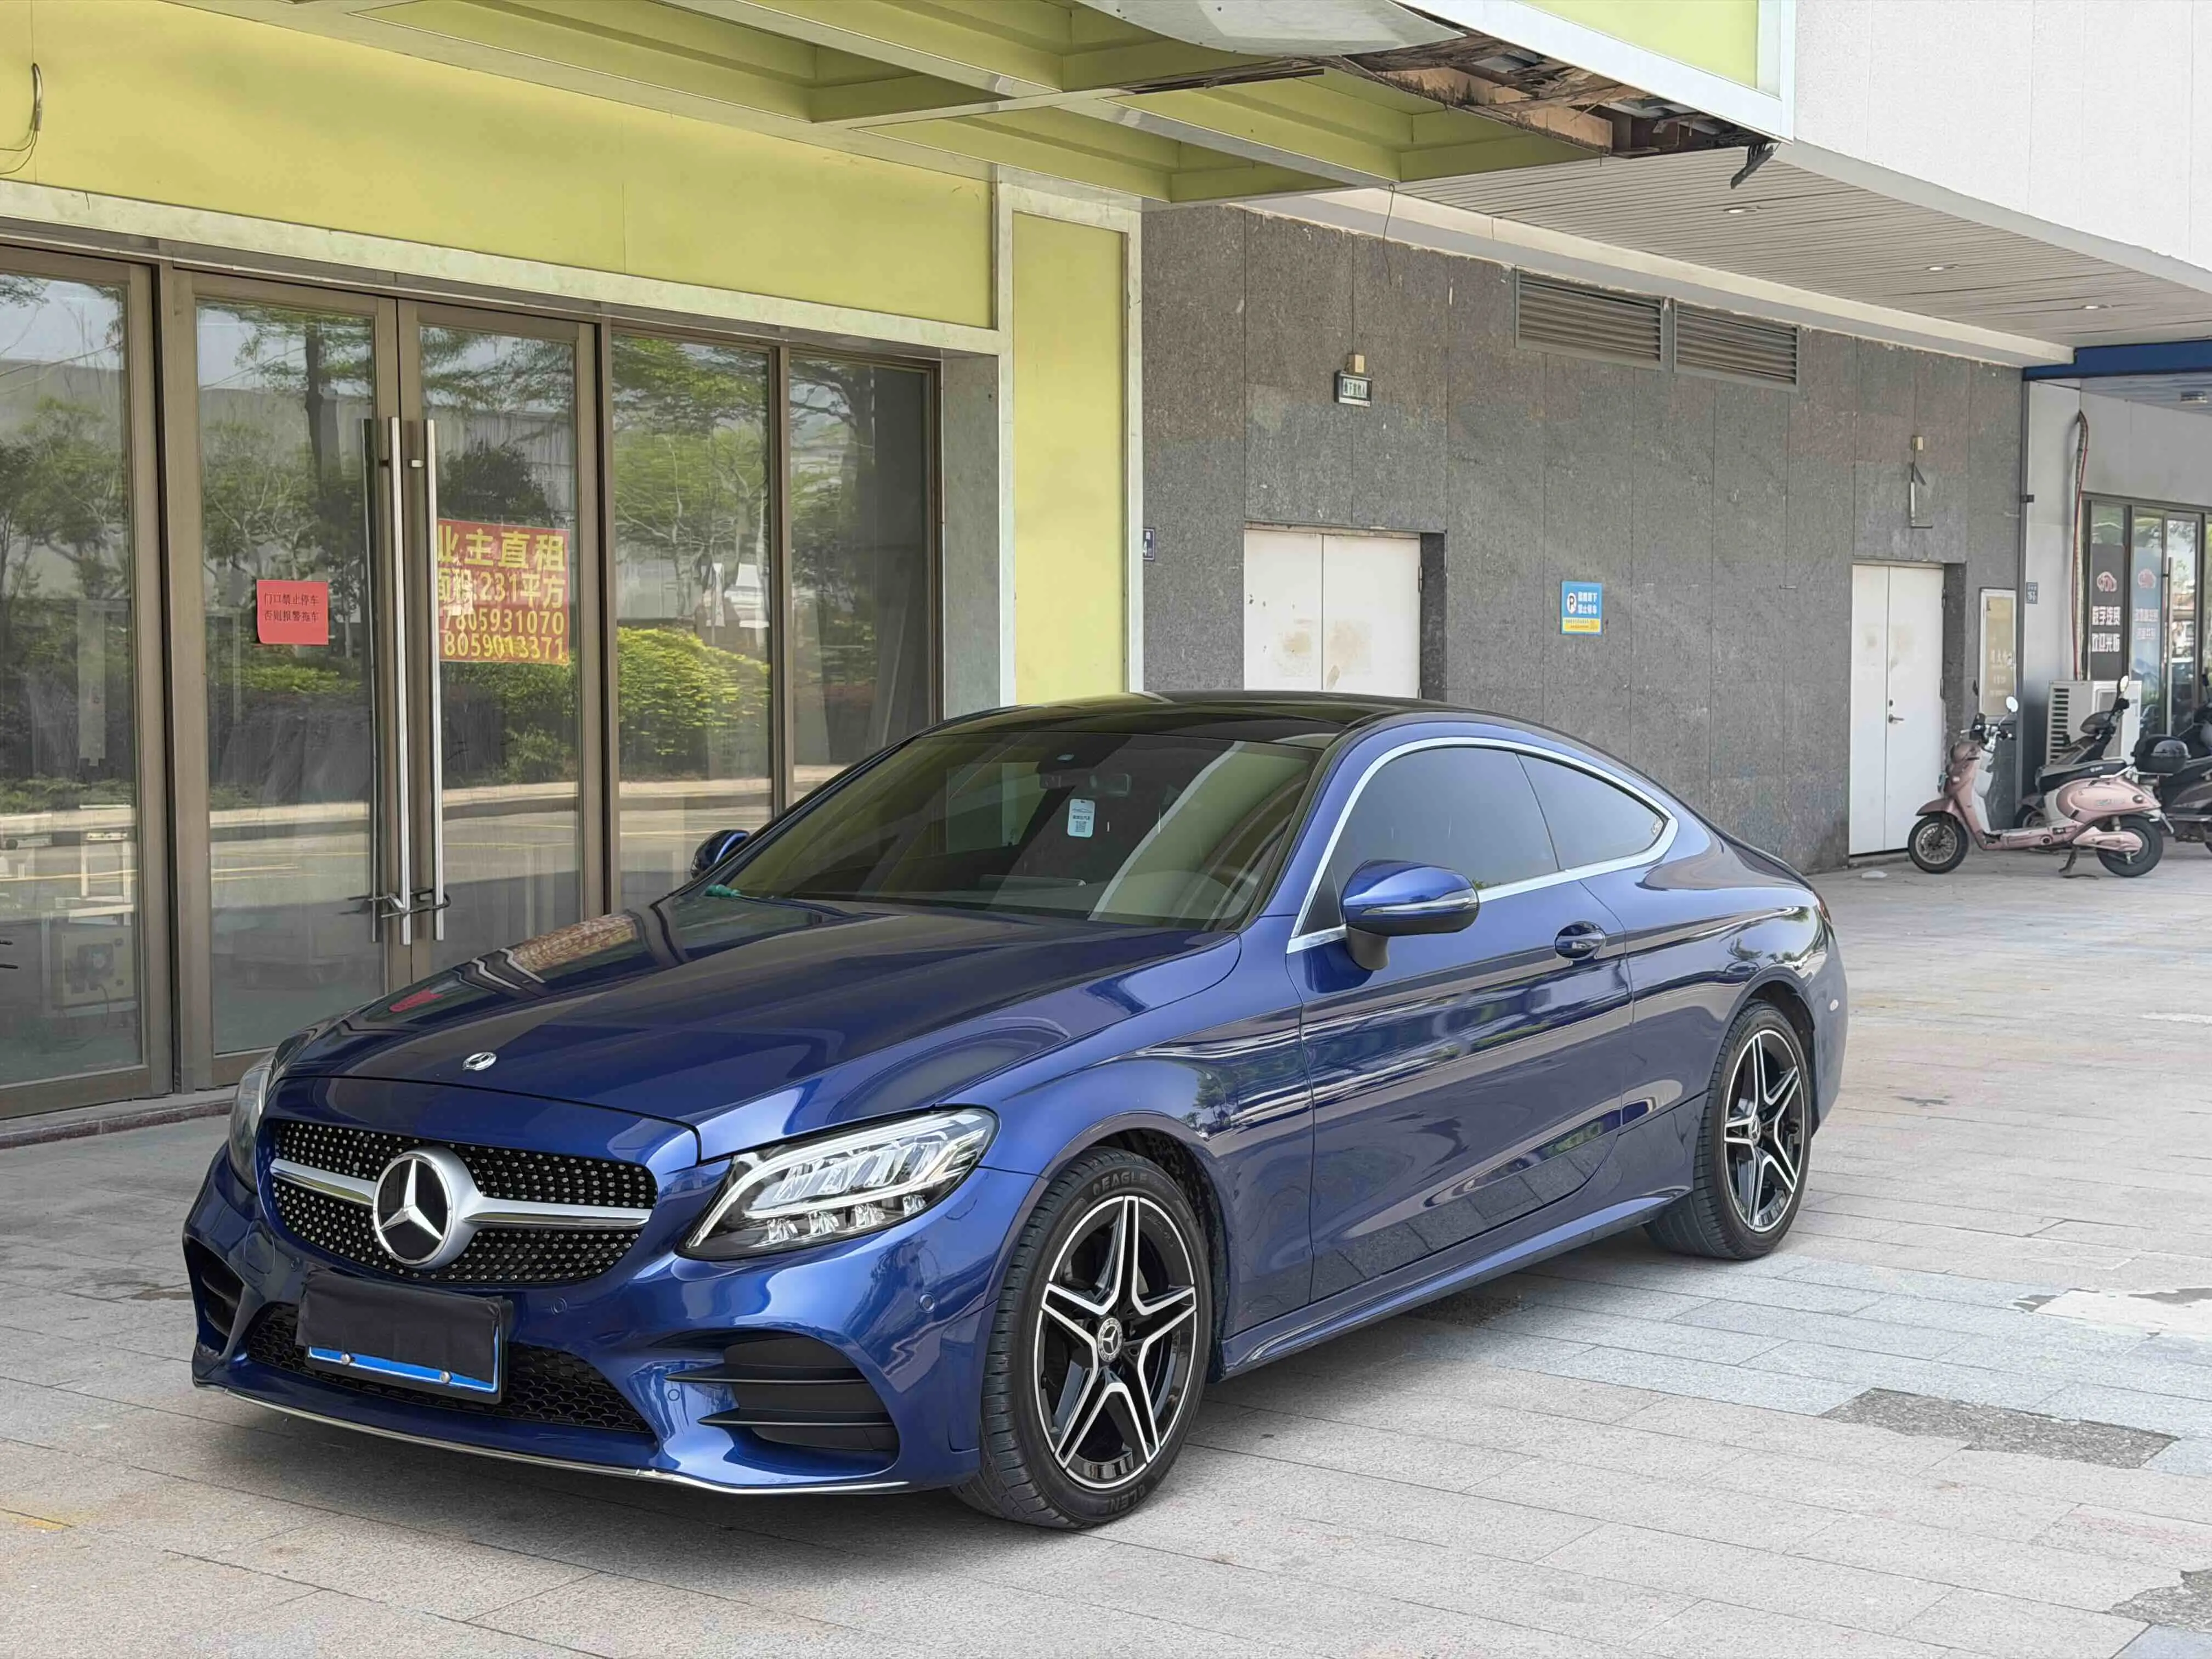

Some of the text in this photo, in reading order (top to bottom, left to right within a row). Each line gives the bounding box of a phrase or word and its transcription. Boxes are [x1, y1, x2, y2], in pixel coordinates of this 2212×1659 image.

[438, 525, 565, 572] 业主直租
[264, 592, 319, 606] 门口禁止停车
[444, 605, 565, 635] 7805931070
[444, 631, 564, 660] 8059013371
